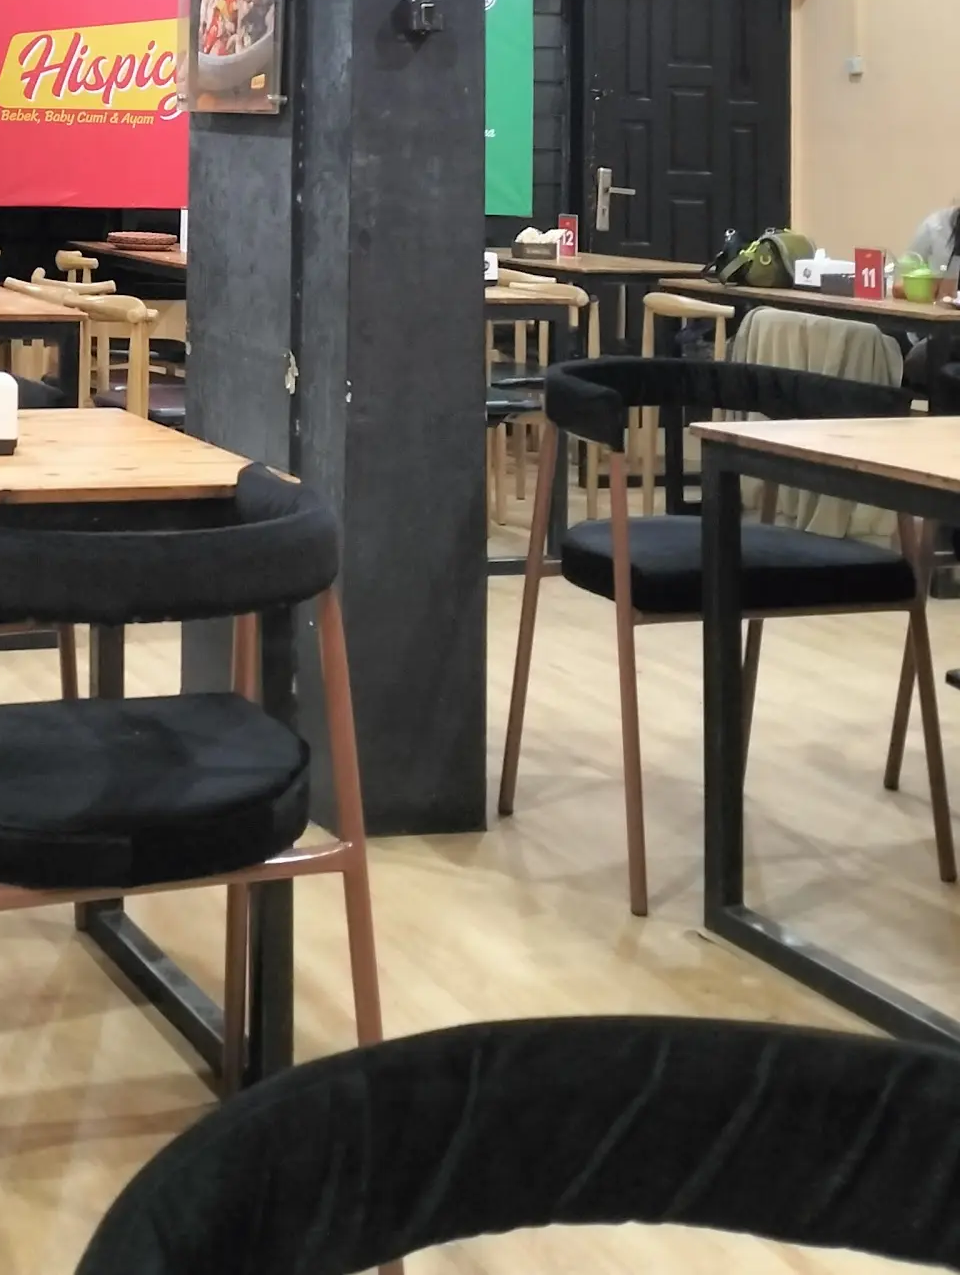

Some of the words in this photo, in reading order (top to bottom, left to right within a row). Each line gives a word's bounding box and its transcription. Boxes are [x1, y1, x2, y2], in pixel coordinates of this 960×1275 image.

[0, 108, 41, 124] Bebek,
[44, 109, 75, 126] Baby
[76, 111, 107, 124] Cumi
[109, 113, 119, 125] &
[120, 113, 155, 129] Ayam
[561, 229, 575, 246] 12
[861, 267, 876, 289] 11
